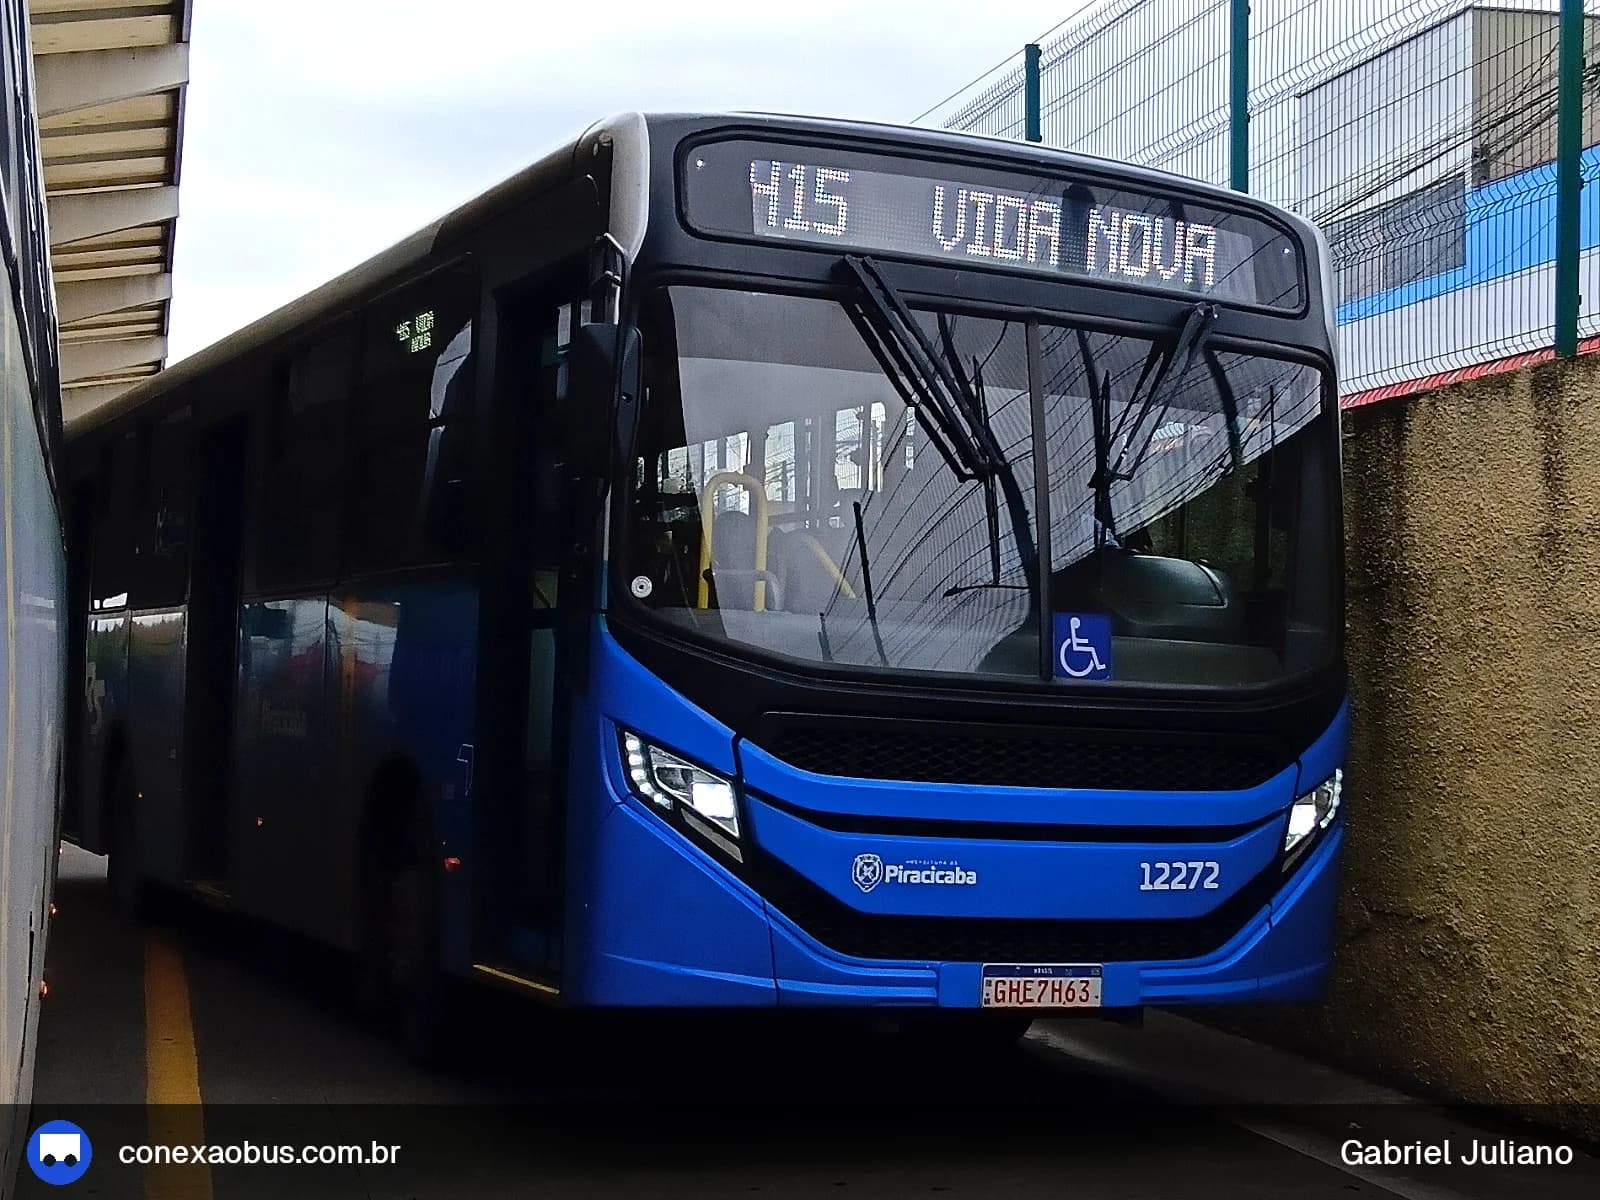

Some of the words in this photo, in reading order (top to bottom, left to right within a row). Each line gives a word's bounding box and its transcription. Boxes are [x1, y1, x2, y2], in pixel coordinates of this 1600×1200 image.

[750, 161, 850, 236] 415
[933, 185, 1062, 265] VIDA
[1086, 208, 1217, 285] NOVA
[884, 865, 977, 884] Piracicaba
[1140, 862, 1219, 890] 12272
[994, 979, 1090, 1003] GHE7H63
